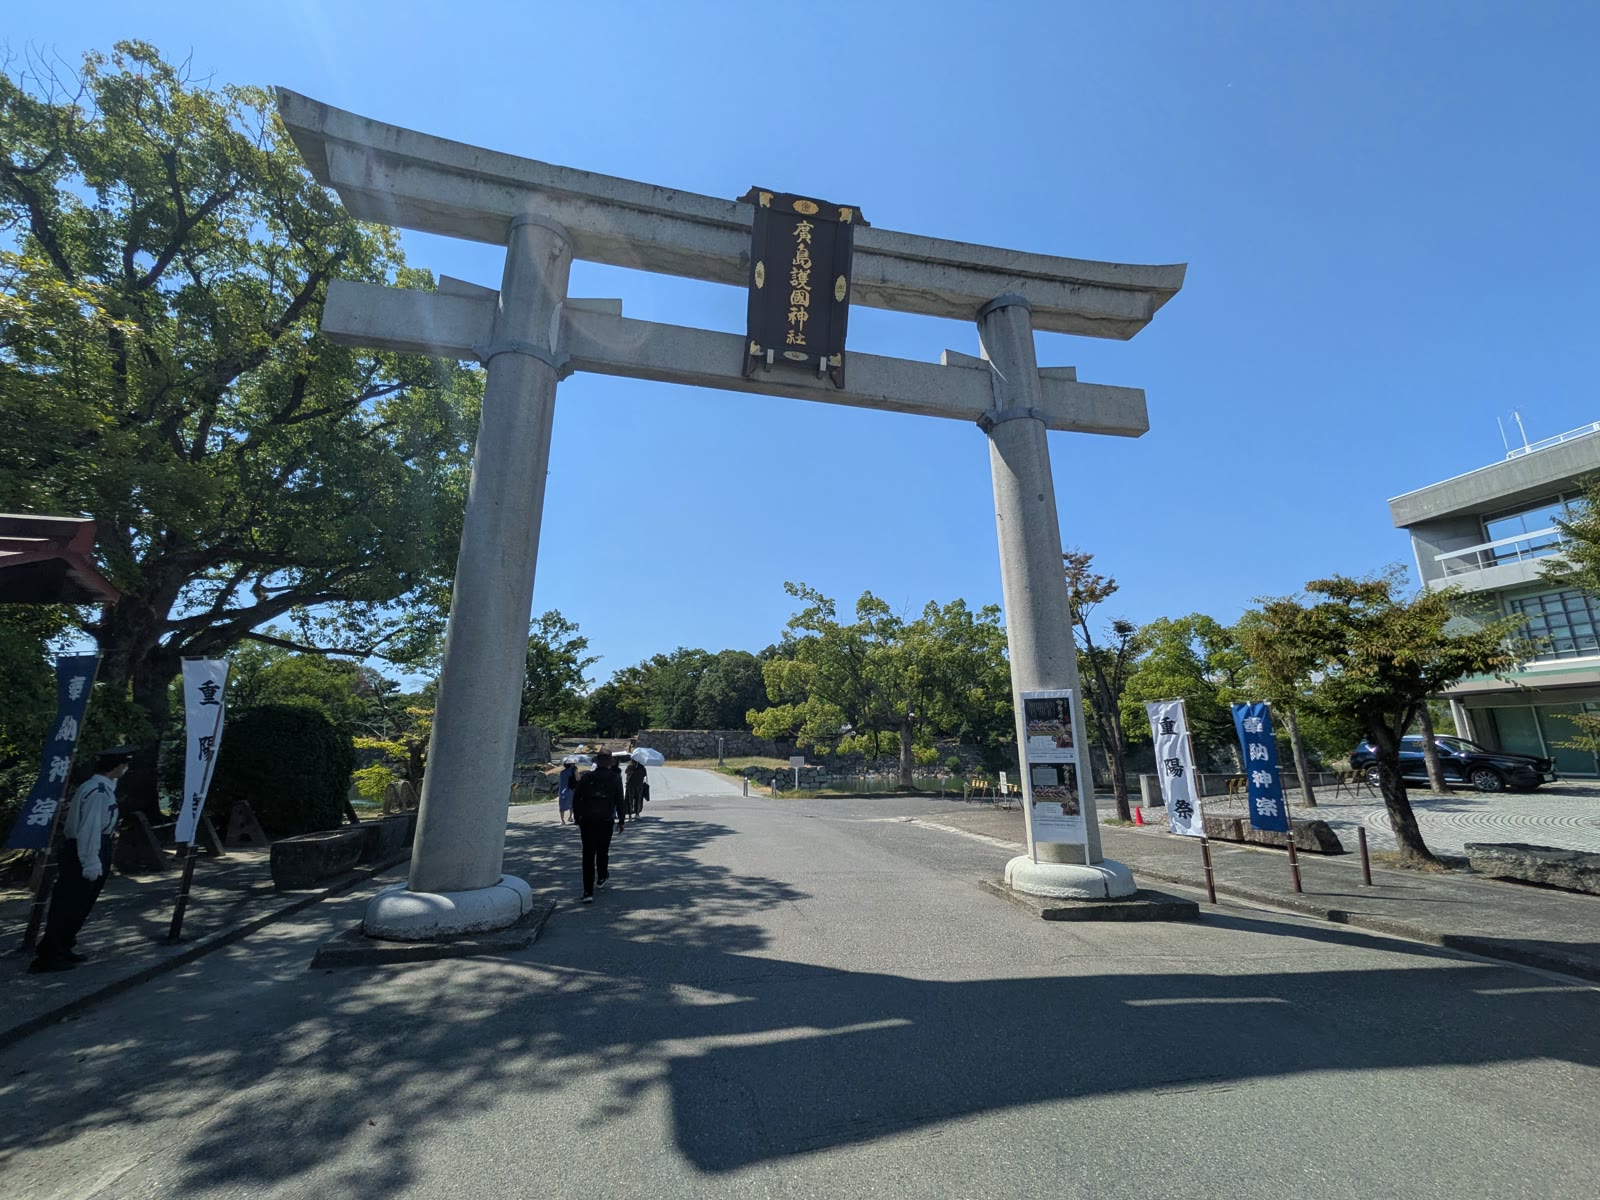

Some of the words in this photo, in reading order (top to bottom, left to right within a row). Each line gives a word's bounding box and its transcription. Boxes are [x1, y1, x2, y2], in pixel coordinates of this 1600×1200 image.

[785, 220, 815, 345] 廣島護國神社
[1159, 716, 1195, 820] 重陽祭
